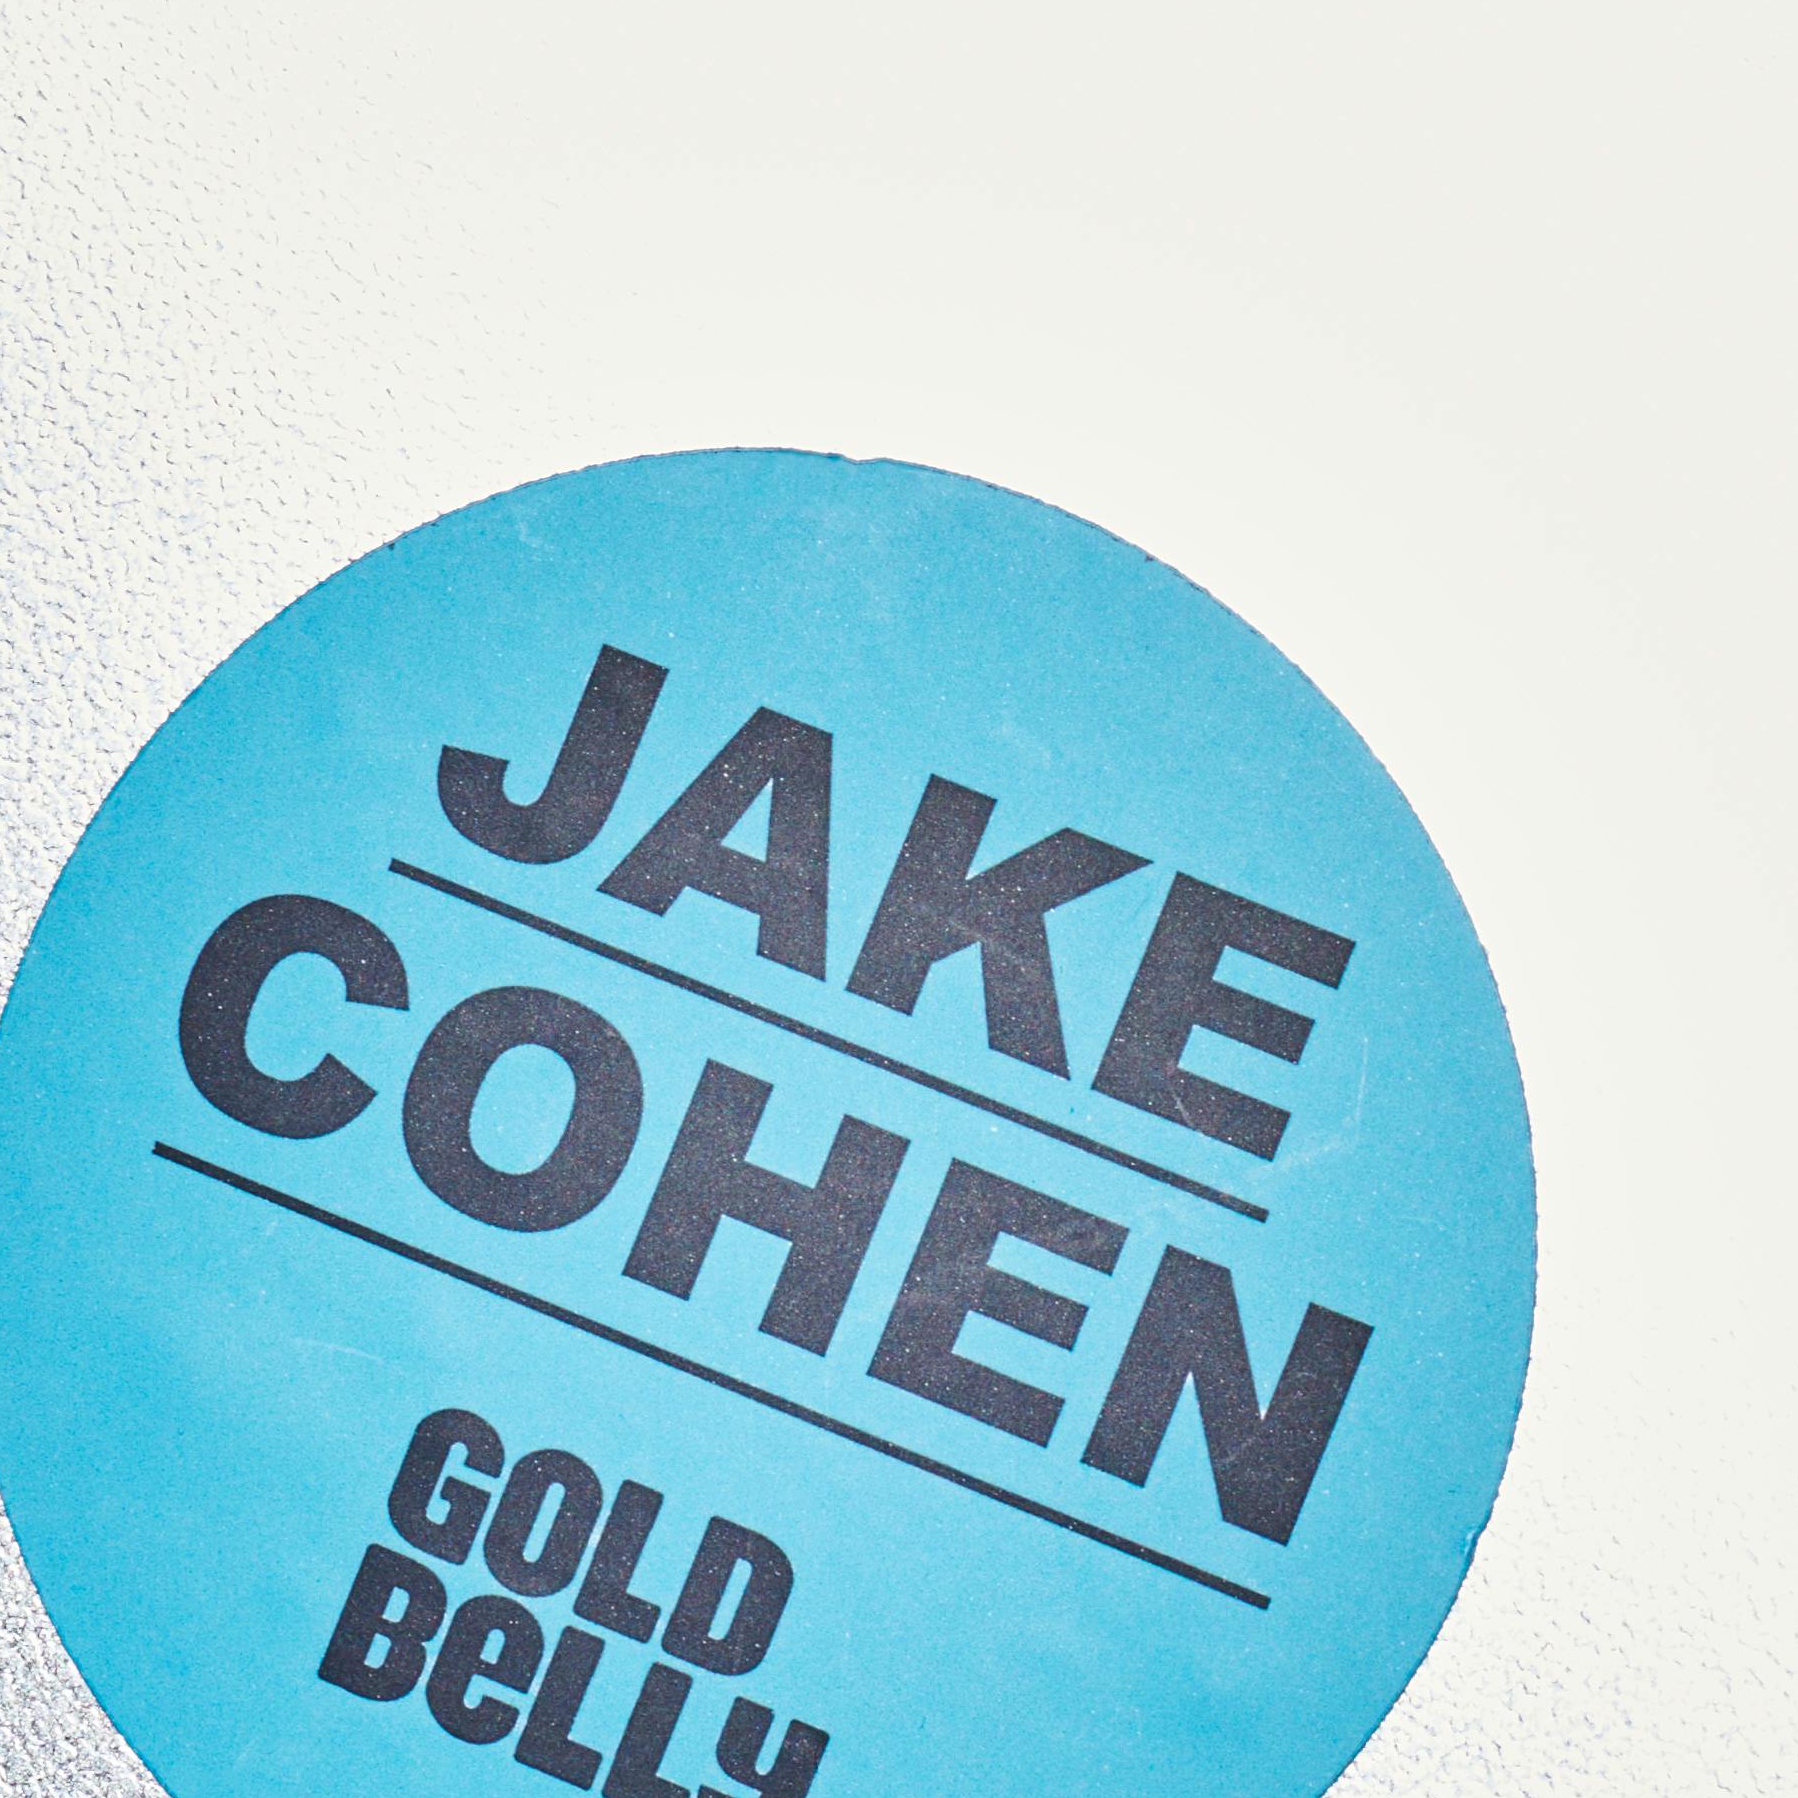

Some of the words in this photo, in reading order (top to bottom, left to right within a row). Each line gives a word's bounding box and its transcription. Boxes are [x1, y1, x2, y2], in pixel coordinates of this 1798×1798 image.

[437, 642, 1358, 1164] JAKE
[177, 893, 1376, 1548] COHEN
[386, 1407, 797, 1678] GOLD
